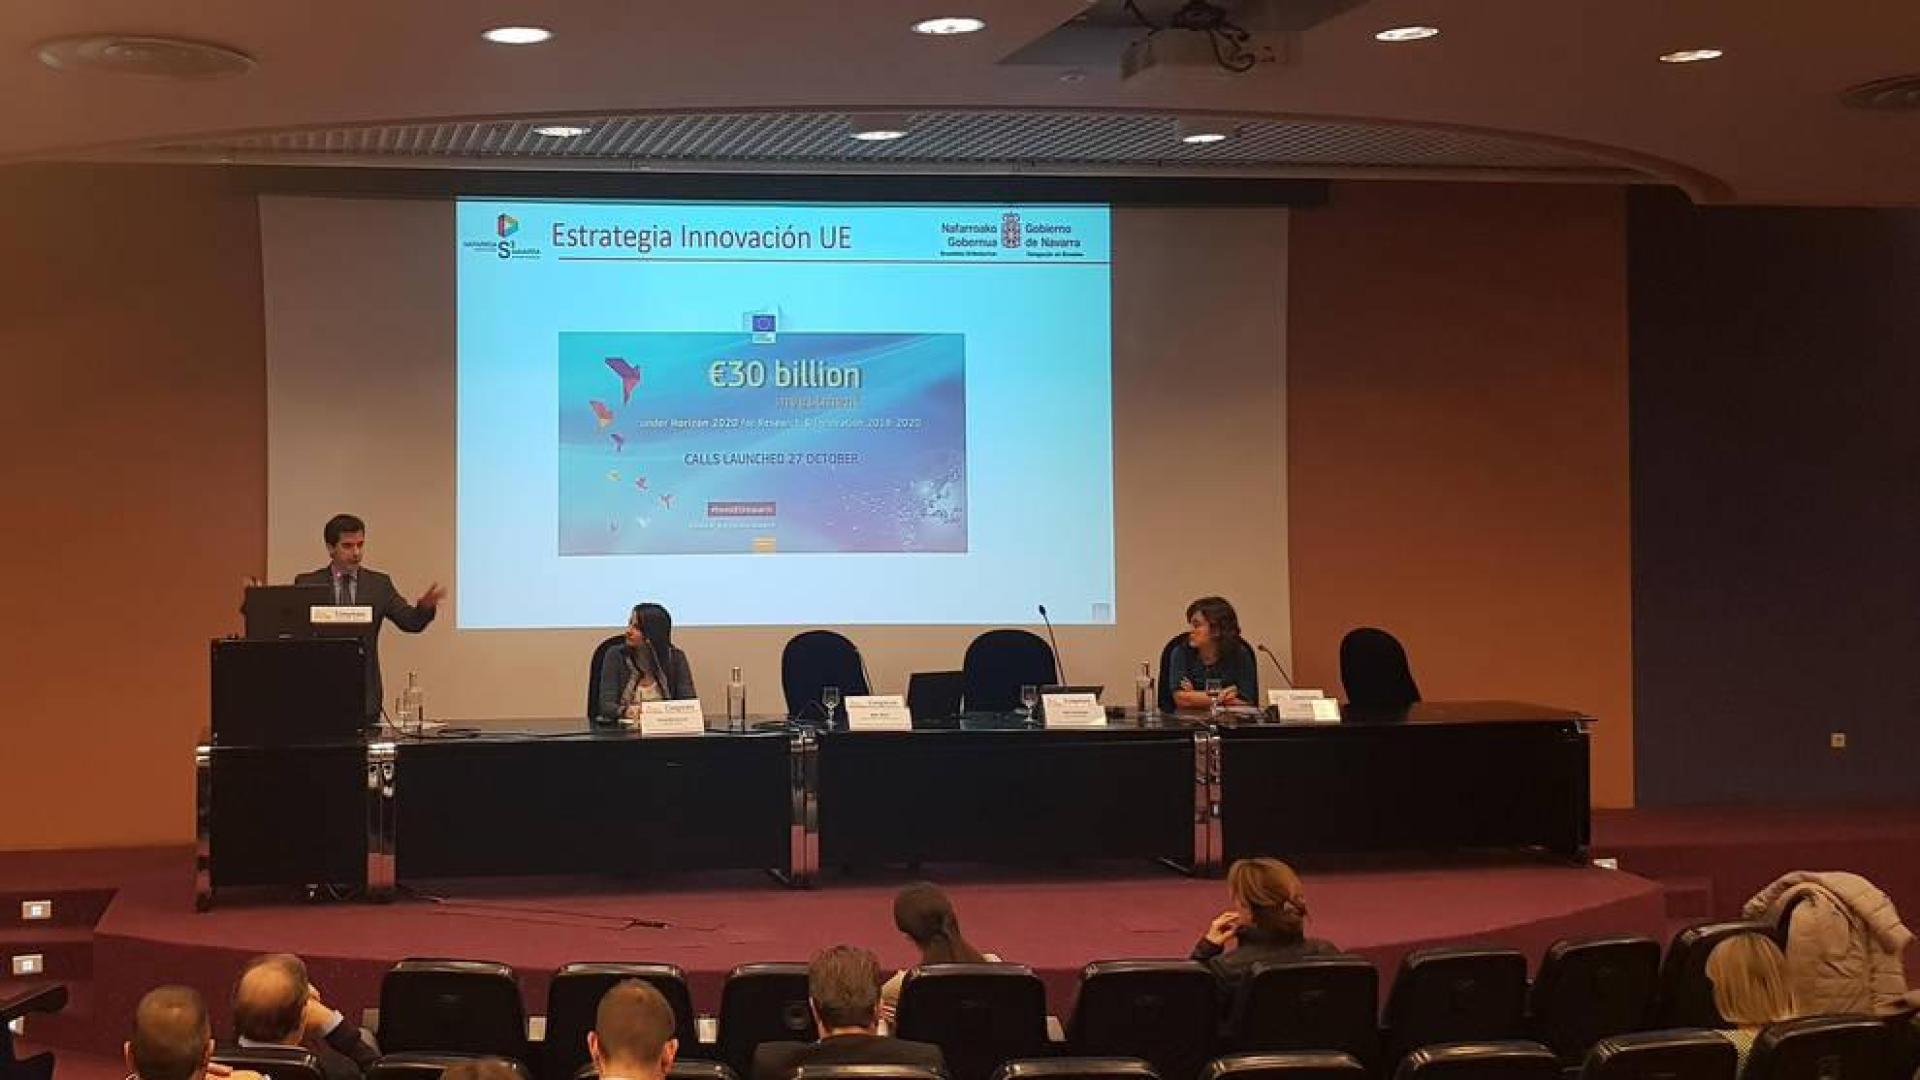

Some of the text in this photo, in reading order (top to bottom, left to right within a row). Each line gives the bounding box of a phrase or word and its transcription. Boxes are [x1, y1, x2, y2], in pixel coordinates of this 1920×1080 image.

[1025, 222, 1071, 234] Gobierno
[552, 222, 852, 253] Estrategia Innovación UE
[1025, 236, 1081, 247] de Navarra
[709, 358, 862, 388] €30 billion
[684, 452, 859, 465] CALLS LAUNCHED 27 OCTOBER
